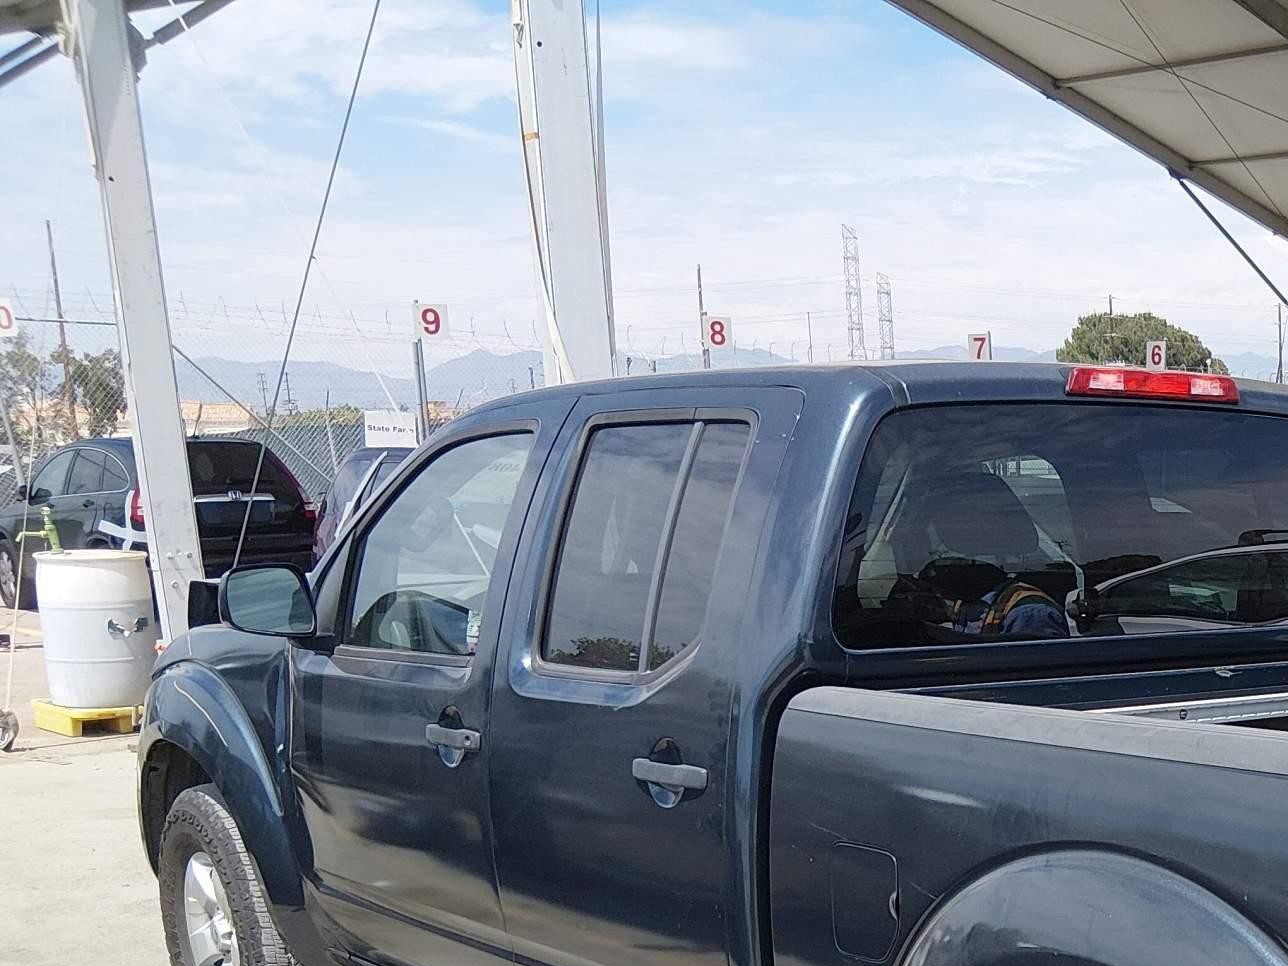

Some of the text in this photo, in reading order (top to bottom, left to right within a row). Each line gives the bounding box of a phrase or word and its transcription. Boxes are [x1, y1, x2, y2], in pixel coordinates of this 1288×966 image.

[421, 308, 441, 335] 9
[710, 320, 726, 346] 8
[973, 337, 986, 360] 7
[1151, 345, 1162, 366] 6
[367, 424, 390, 432] State
